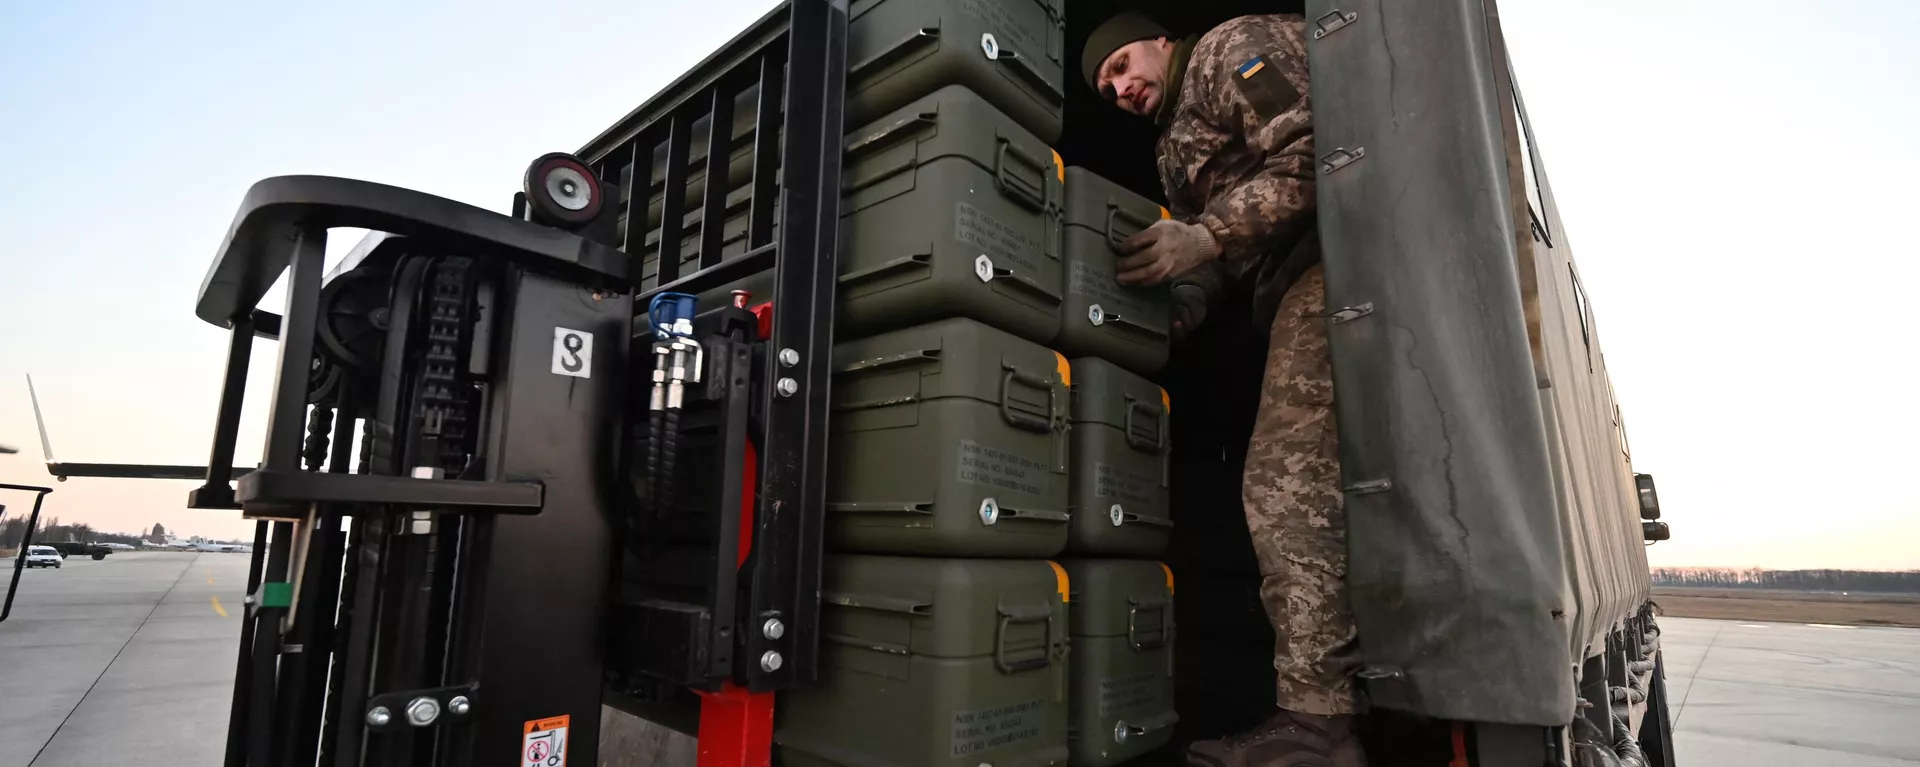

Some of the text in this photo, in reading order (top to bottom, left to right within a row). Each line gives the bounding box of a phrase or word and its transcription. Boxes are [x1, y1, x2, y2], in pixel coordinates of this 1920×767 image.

[959, 217, 987, 236] SERIAL
[959, 230, 975, 242] LOT
[963, 444, 981, 454] NSN
[962, 457, 989, 470] SERIAL
[961, 470, 978, 480] LOT
[955, 714, 974, 724] NSN
[955, 727, 983, 739] SERIAL
[954, 744, 971, 755] LOT
